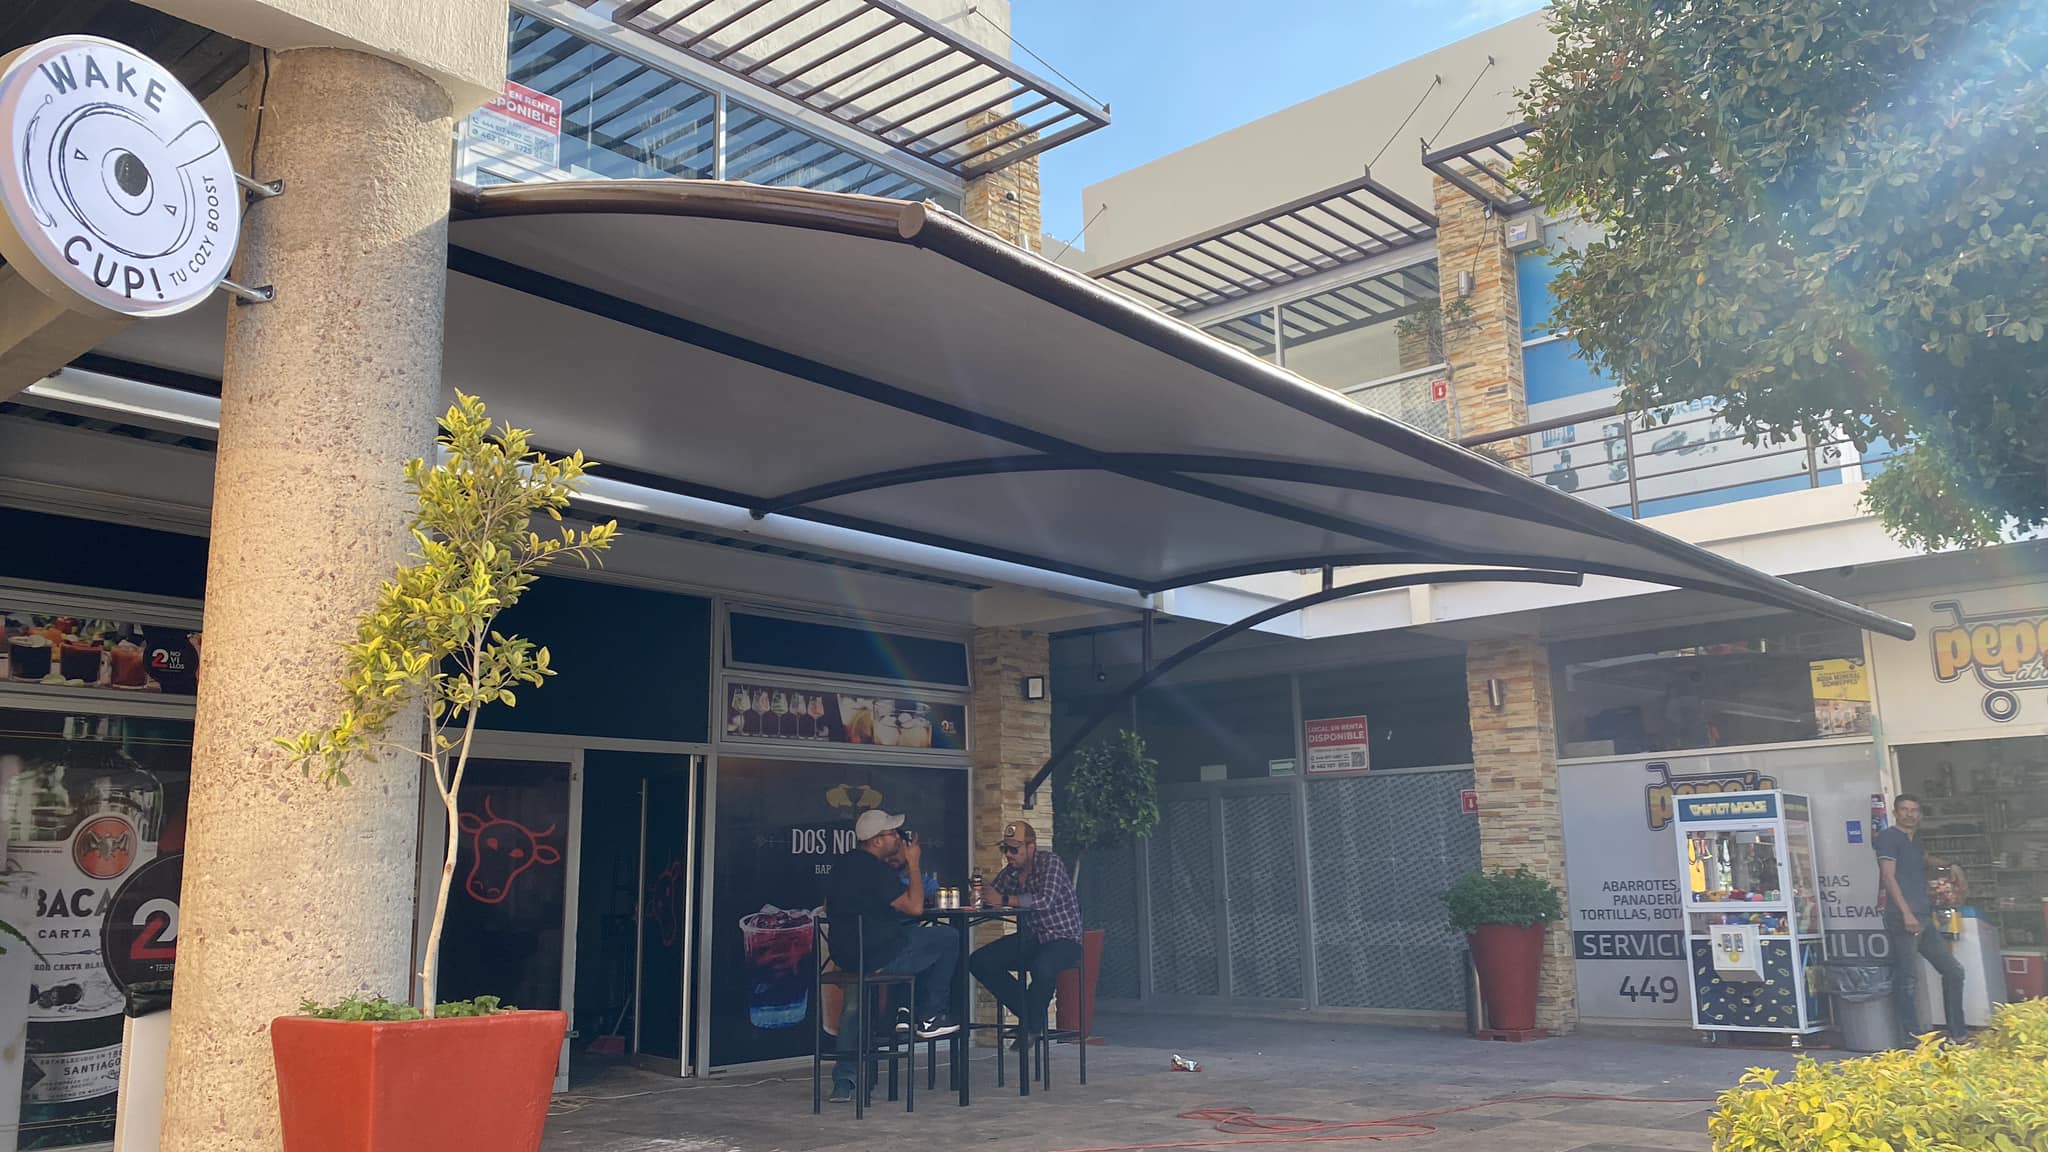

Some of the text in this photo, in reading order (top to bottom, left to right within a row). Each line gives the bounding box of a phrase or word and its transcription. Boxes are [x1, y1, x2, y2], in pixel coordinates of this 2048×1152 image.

[39, 55, 166, 113] WAKE
[509, 90, 556, 115] EN RENTA
[169, 175, 219, 287] TU COZY BOOST
[64, 235, 164, 299] CUP!
[152, 648, 169, 668] 2
[1308, 730, 1365, 743] DISPONIBLE
[791, 828, 827, 855] DOS
[1602, 879, 1680, 893] ABARROTES,
[1580, 909, 1651, 922] TORTILLAS,
[38, 928, 91, 939] CARTA
[130, 898, 179, 960] 2
[1583, 934, 1687, 956] SERVICI
[53, 963, 82, 971] CARTA
[1619, 975, 1679, 1004] 449
[63, 1057, 120, 1076] SANTIAGO
